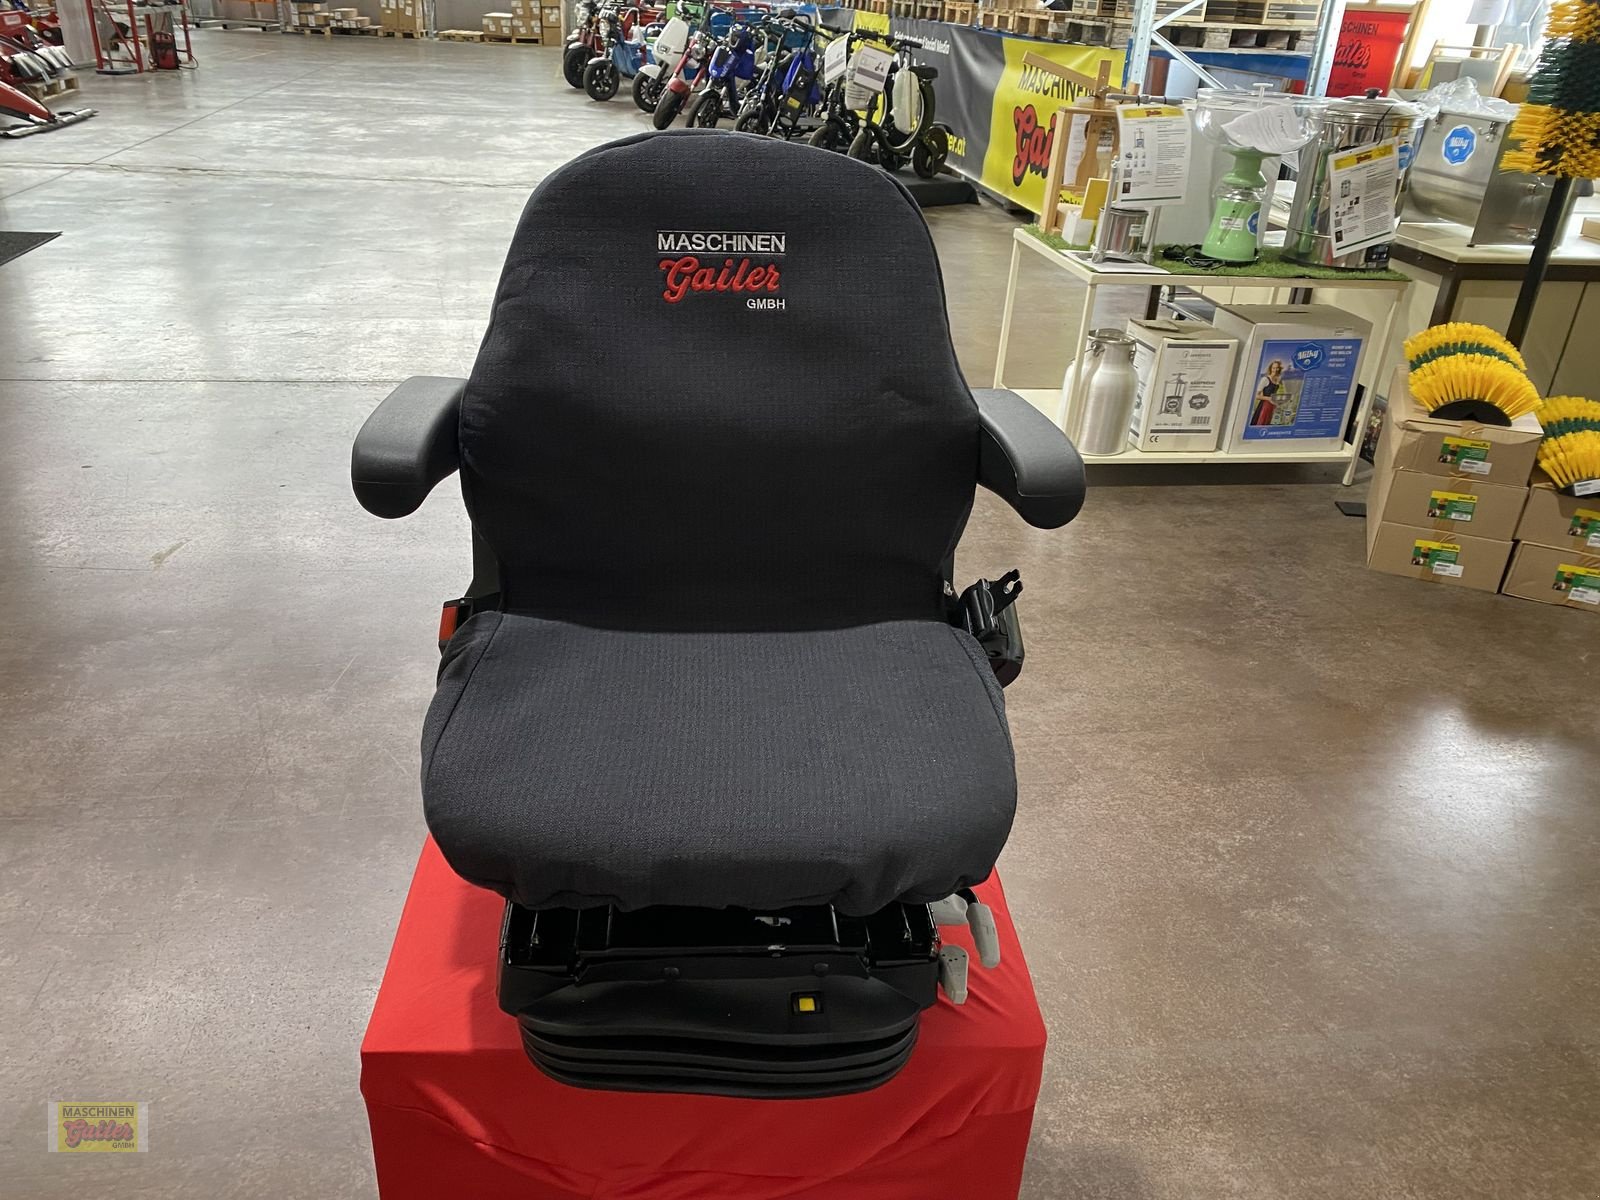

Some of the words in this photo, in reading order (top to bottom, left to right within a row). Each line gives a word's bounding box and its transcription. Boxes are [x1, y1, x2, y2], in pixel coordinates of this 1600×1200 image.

[1341, 22, 1379, 36] SCHINEN
[925, 37, 937, 51] Social
[937, 39, 950, 55] Media
[1334, 39, 1370, 69] ailer
[1018, 64, 1096, 102] MASCHIN
[946, 132, 966, 157] er.at
[1013, 104, 1057, 187] Gai
[657, 232, 786, 252] MASCHINEN
[659, 256, 780, 303] Gailer
[746, 298, 786, 310] GMBH
[1297, 349, 1320, 360] Milky
